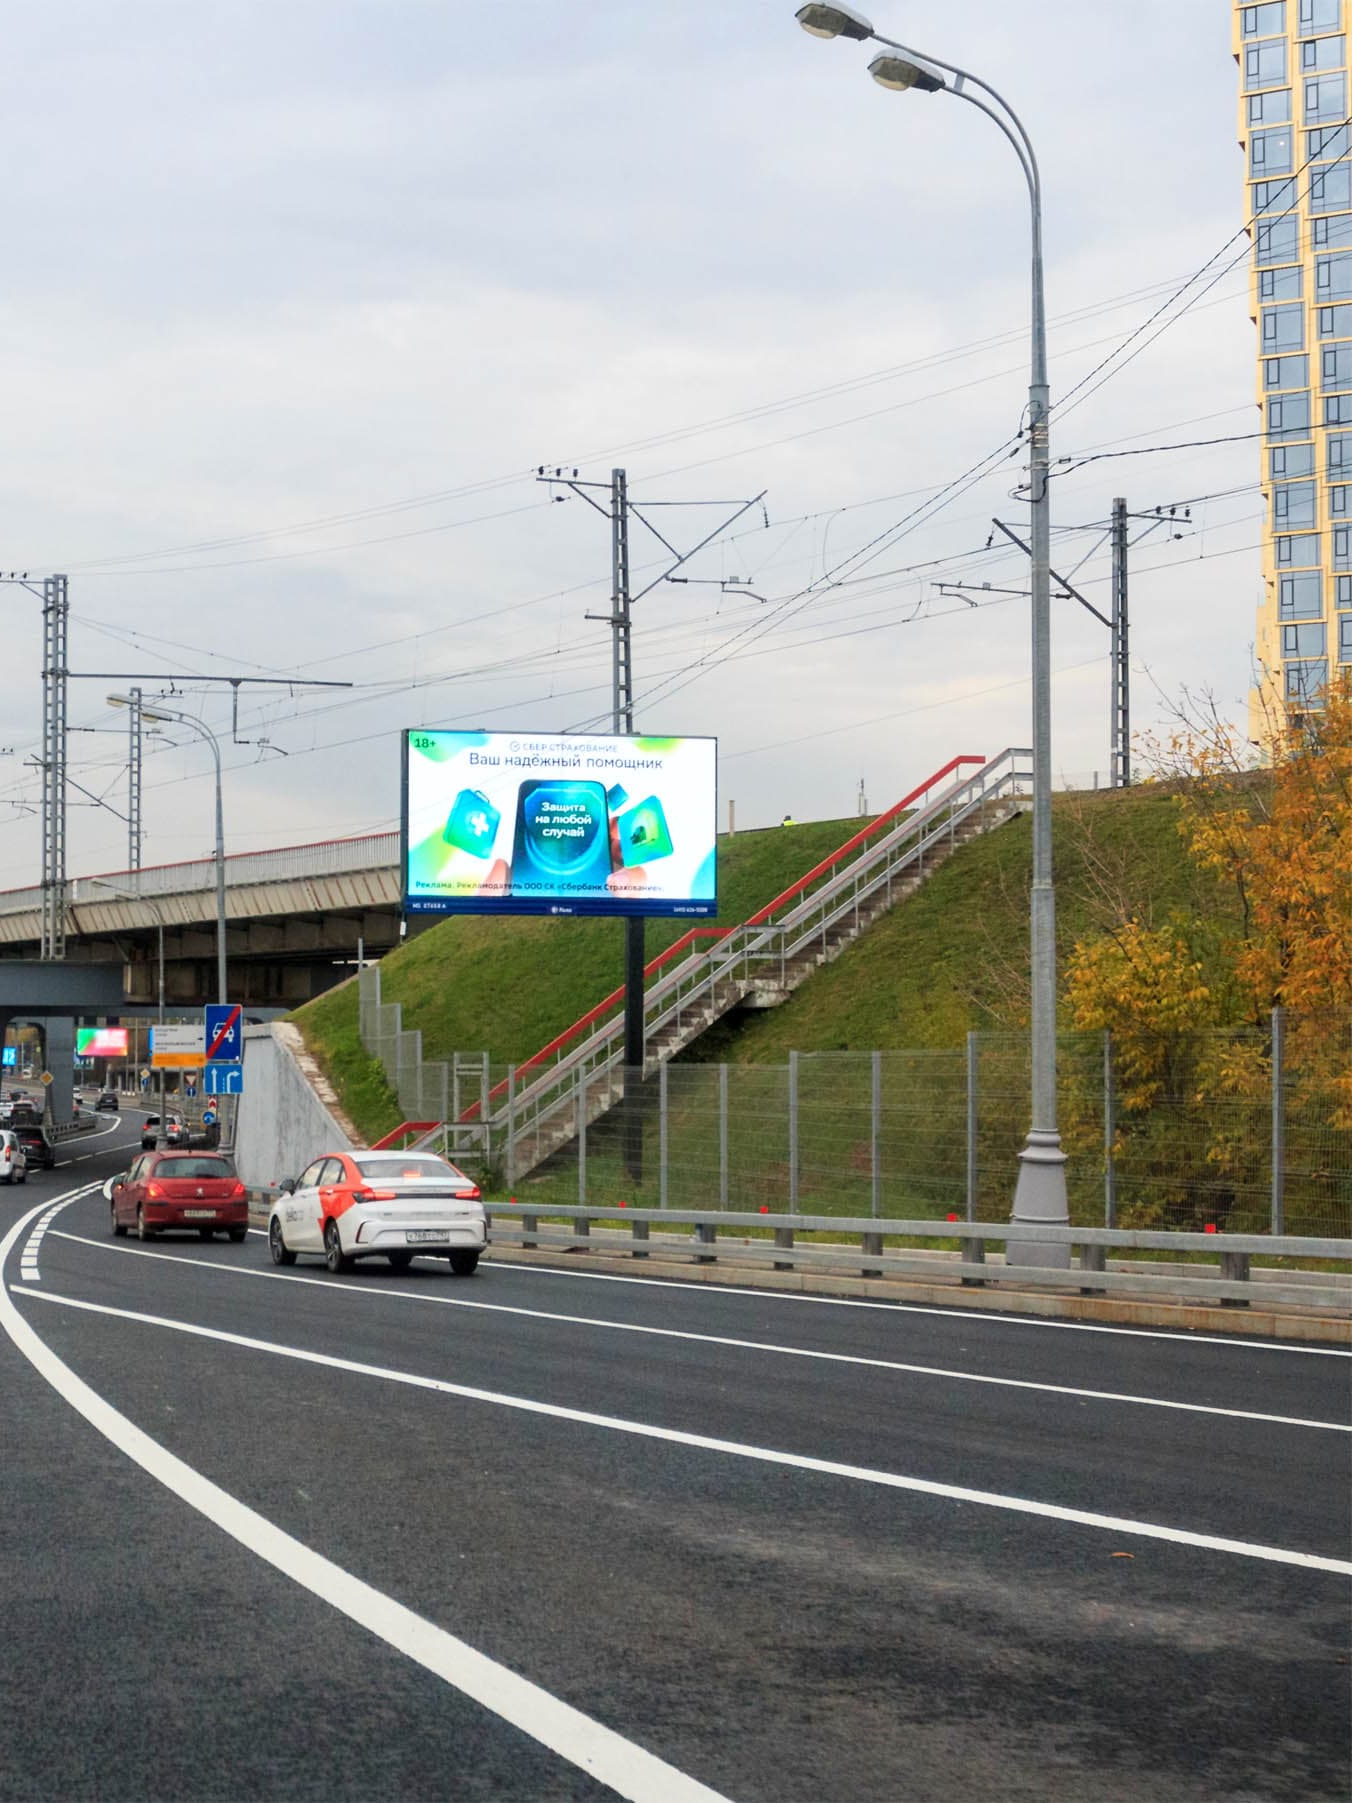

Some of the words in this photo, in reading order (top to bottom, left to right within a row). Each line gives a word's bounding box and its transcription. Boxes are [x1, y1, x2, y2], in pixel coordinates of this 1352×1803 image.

[415, 738, 436, 748] 18+
[470, 752, 500, 766] Ваш
[505, 753, 581, 768] надёжный
[586, 758, 663, 770] помощник
[542, 802, 585, 812] Защита
[535, 815, 550, 824] на
[551, 814, 592, 824] любой
[542, 826, 585, 839] случай
